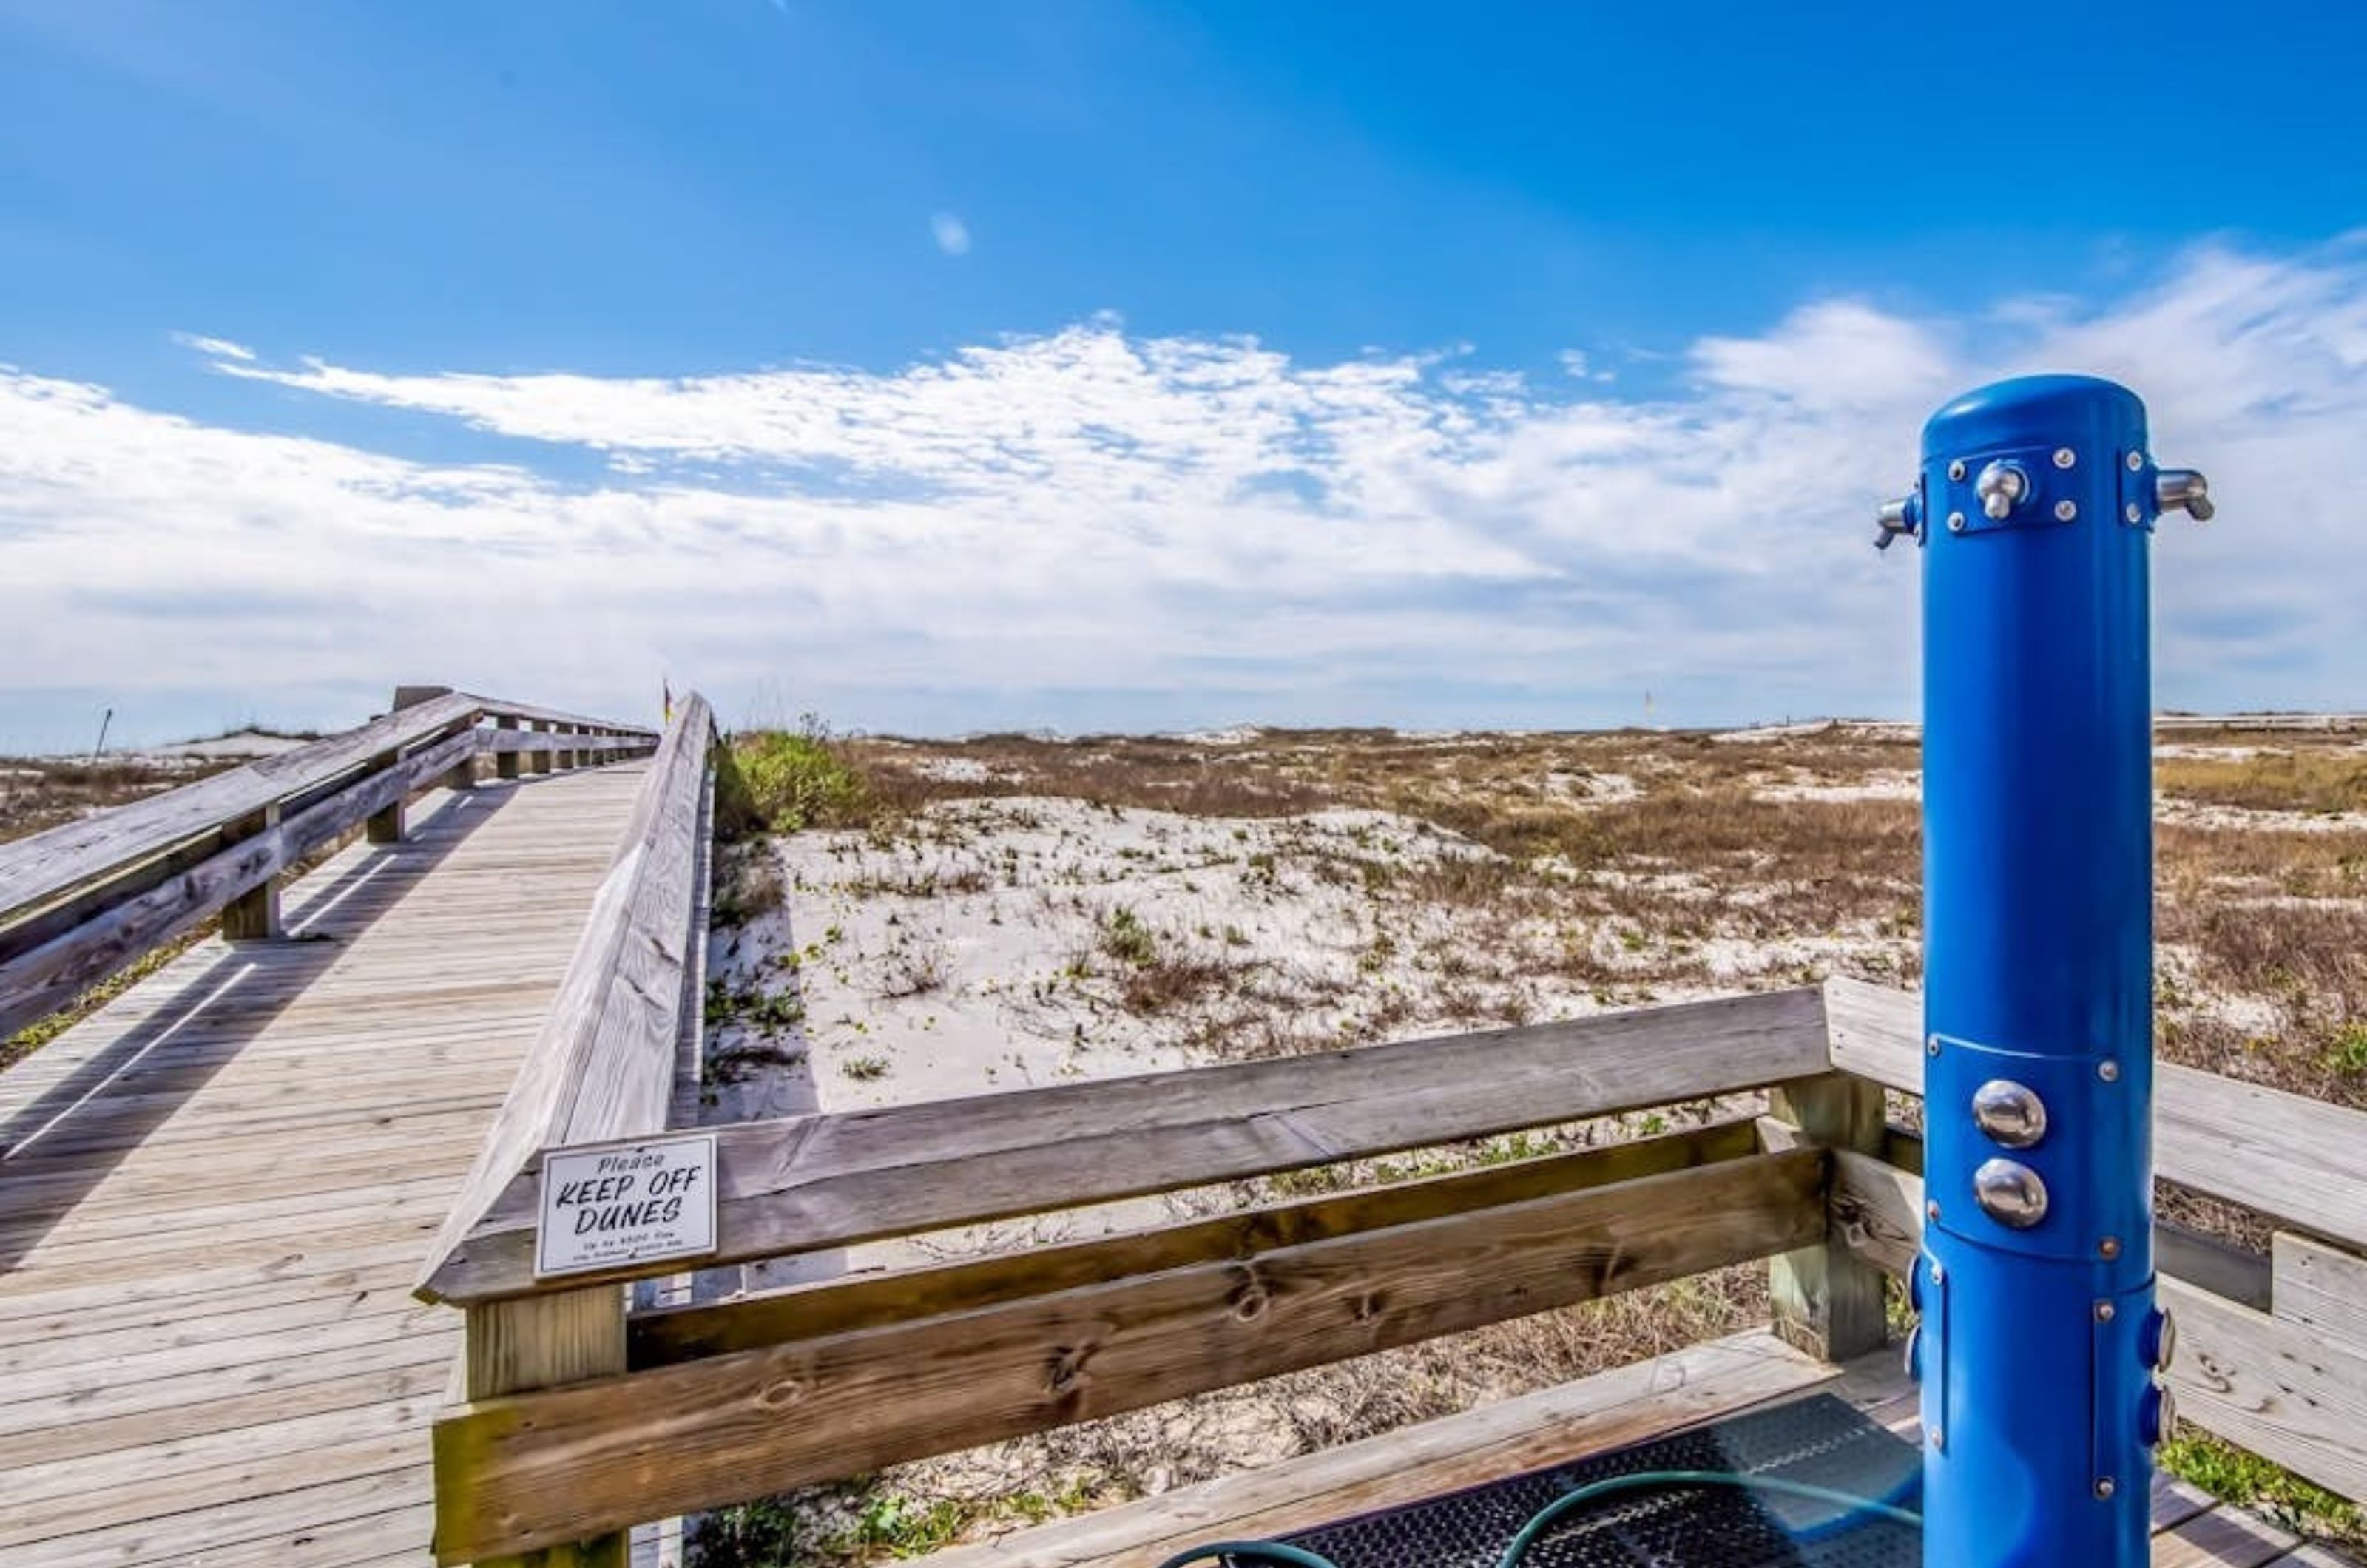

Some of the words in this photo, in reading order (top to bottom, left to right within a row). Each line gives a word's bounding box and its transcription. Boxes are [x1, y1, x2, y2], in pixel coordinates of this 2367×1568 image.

[598, 1154, 665, 1173] Please
[556, 1175, 634, 1209] KEEP
[649, 1166, 701, 1196] OFF
[575, 1197, 682, 1234] DUNES
